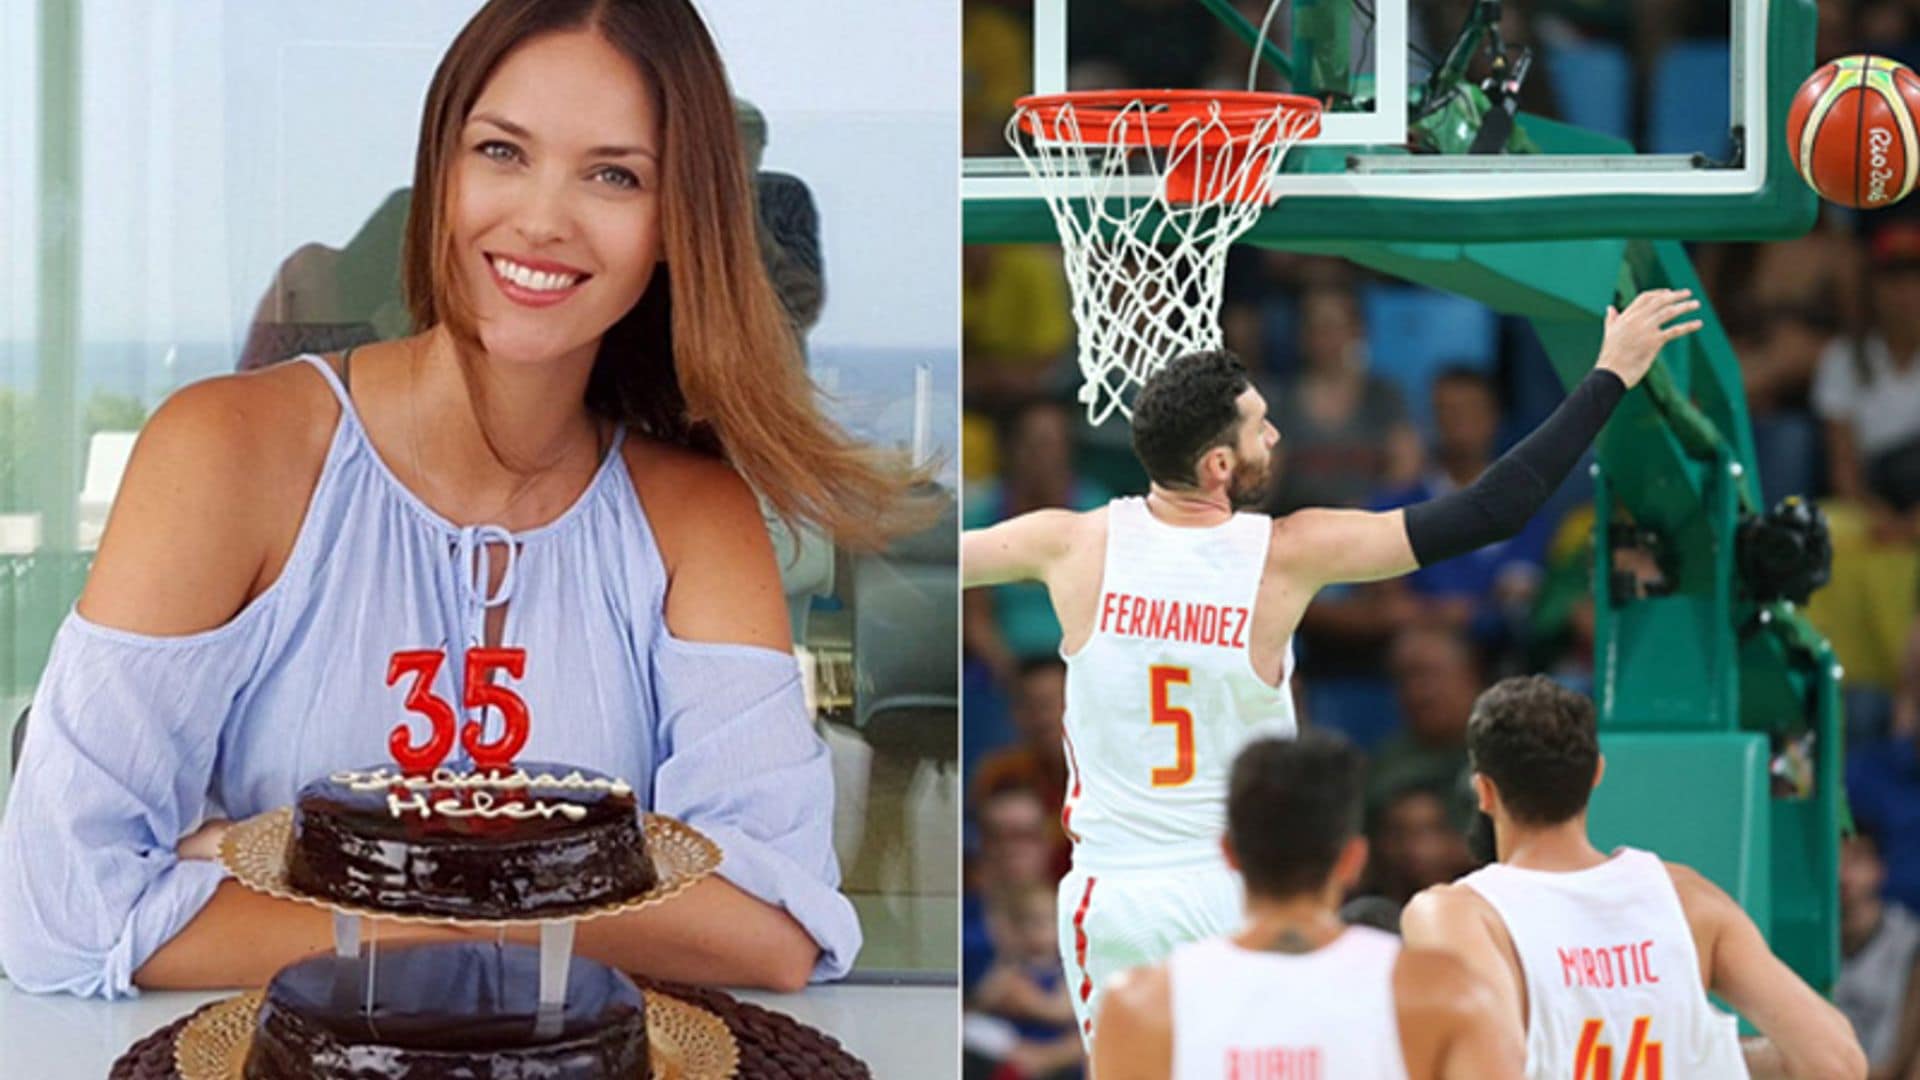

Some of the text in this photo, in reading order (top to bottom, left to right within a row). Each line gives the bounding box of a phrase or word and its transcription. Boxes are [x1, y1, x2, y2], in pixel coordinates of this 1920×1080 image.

[1869, 126, 1893, 168] Rio
[1100, 591, 1249, 649] FERNANDEZ
[386, 647, 530, 770] 35
[1148, 662, 1196, 788] 5
[386, 791, 587, 818] Helen
